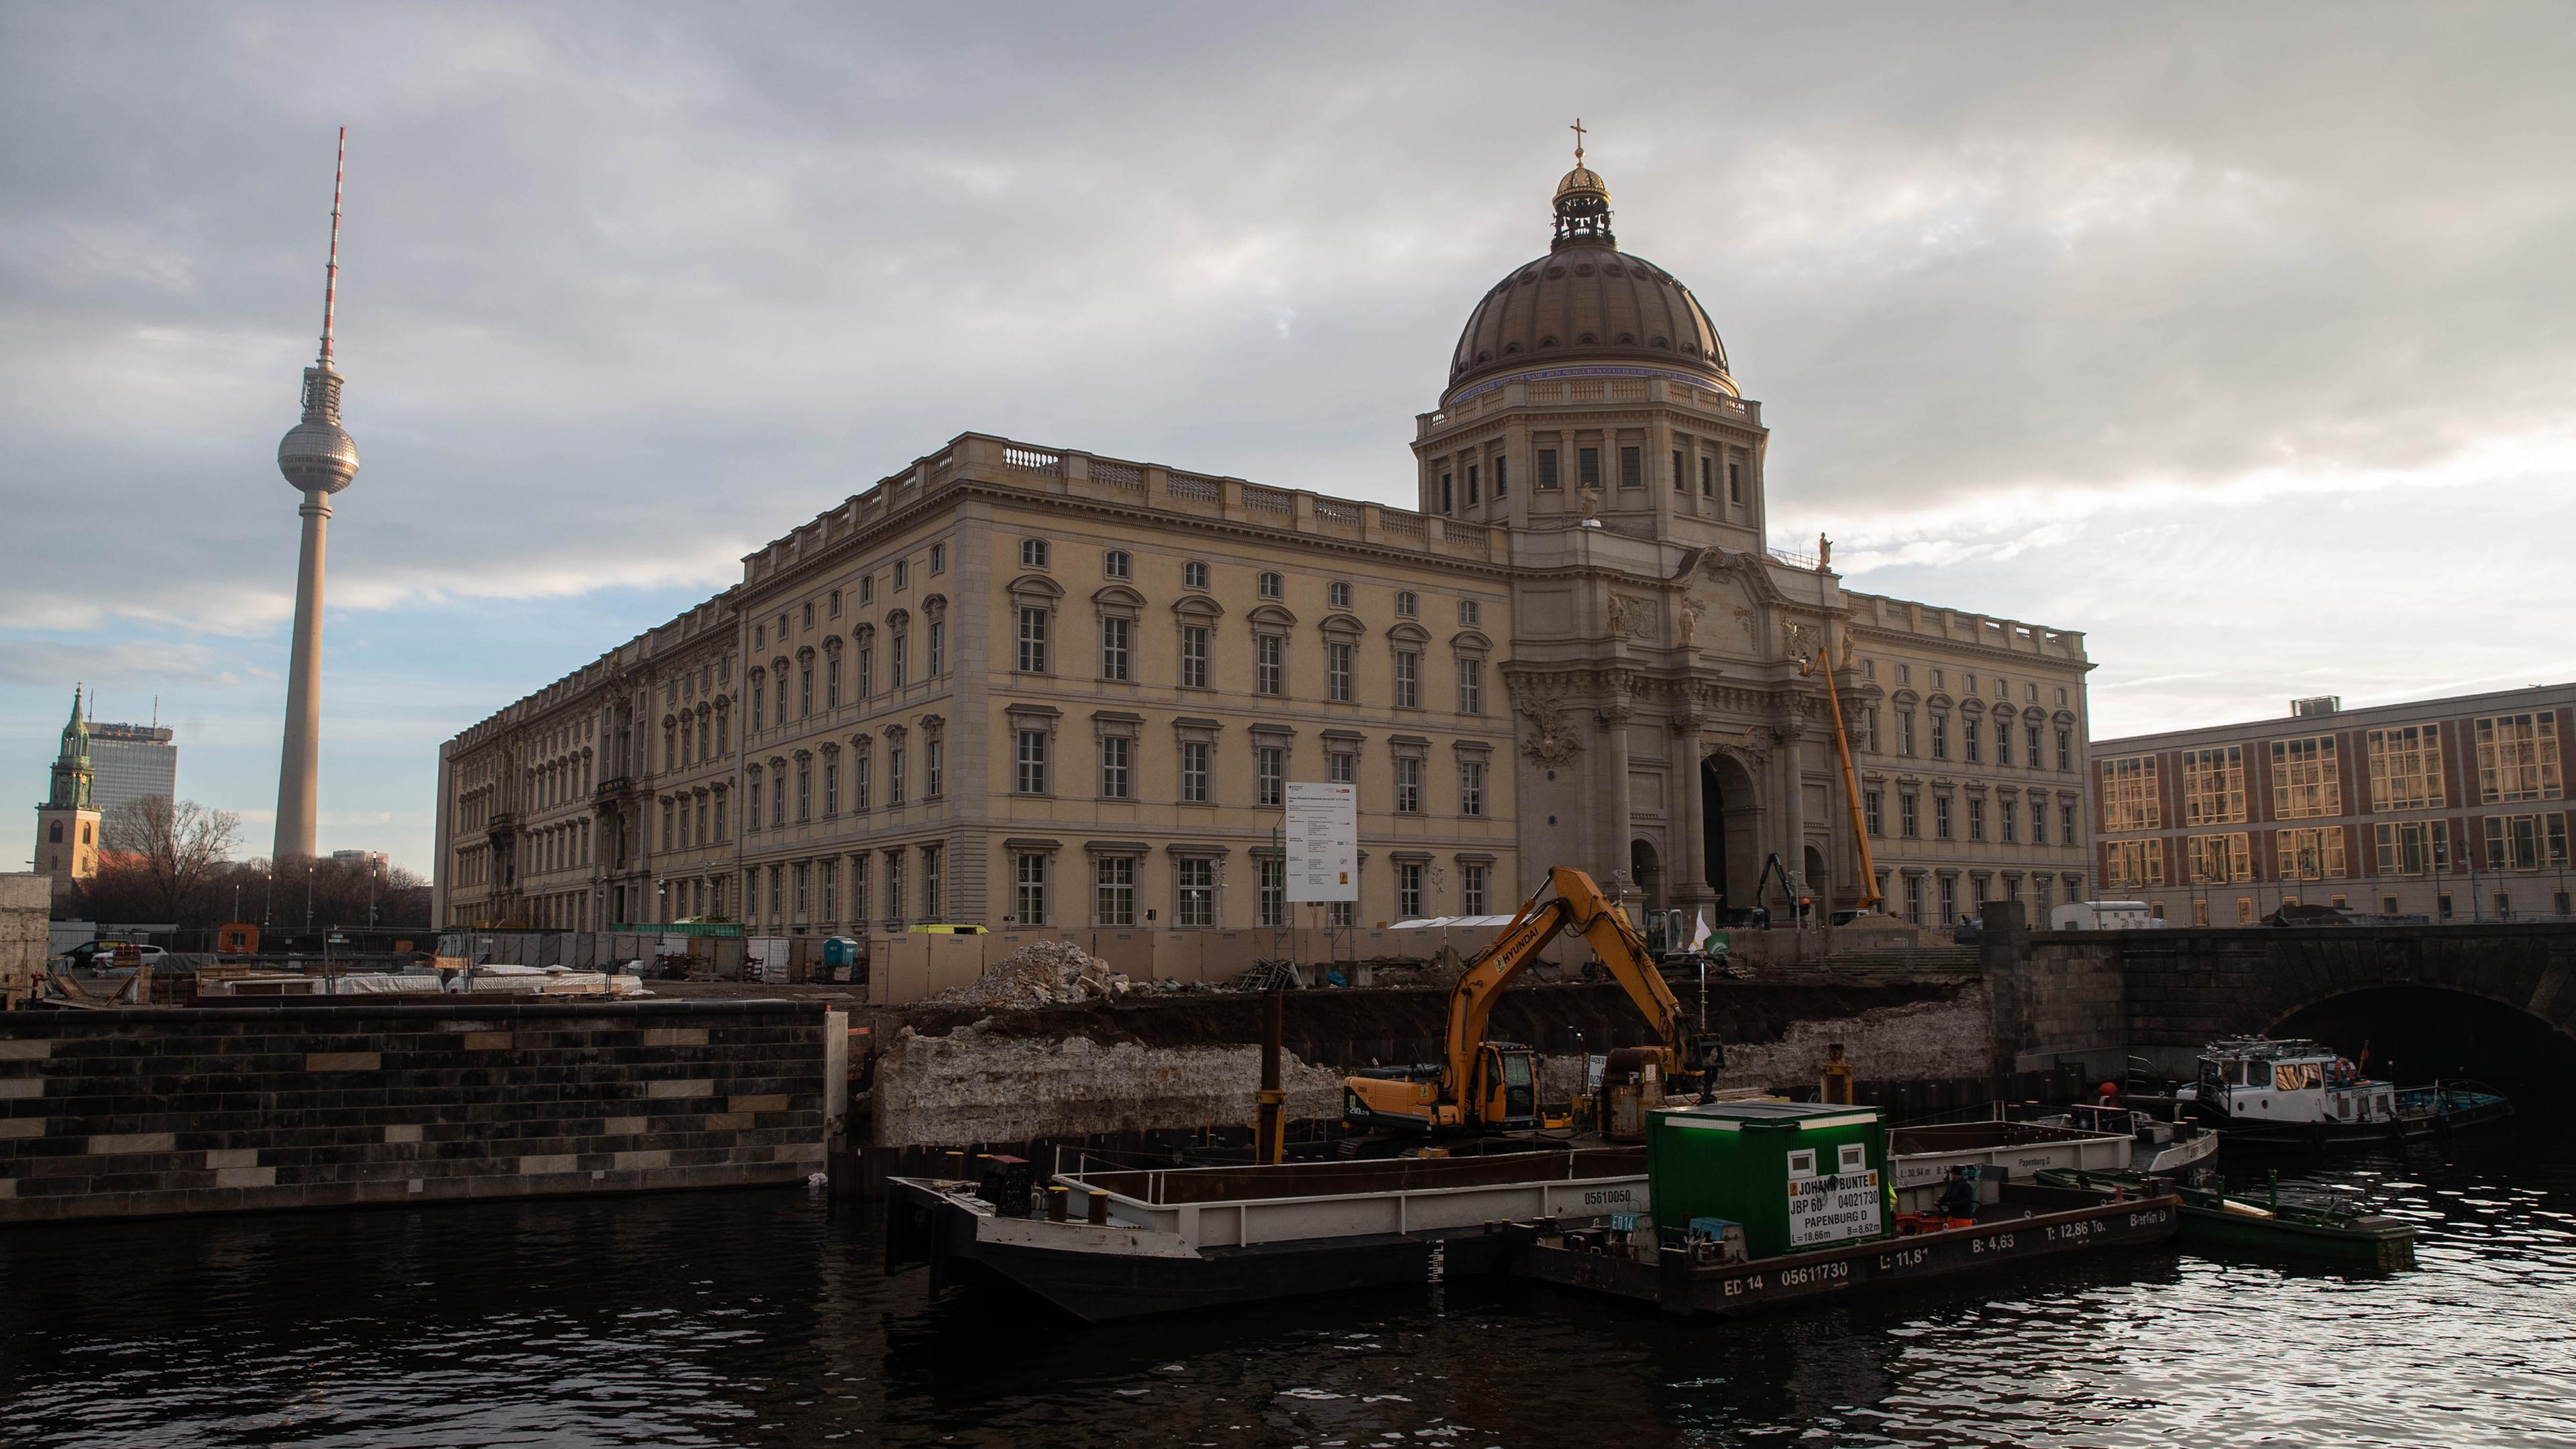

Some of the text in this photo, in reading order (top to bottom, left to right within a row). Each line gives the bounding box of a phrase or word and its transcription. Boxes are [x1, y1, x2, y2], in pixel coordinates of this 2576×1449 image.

[1503, 926, 1539, 964] HYUNDAI
[1799, 1175, 1868, 1195] JOHANN BUNTE
[1585, 1189, 1631, 1205] 05610050
[1790, 1190, 1878, 1215] JBP 60 04021730
[1805, 1210, 1867, 1228] PAPENBURG D
[1792, 1223, 1880, 1243] L=18,66m B=8,62m
[1724, 1279, 1742, 1296] ED
[1747, 1274, 1764, 1290] 14
[1781, 1261, 1848, 1286] 05611730
[1880, 1255, 1890, 1269] L:
[1972, 1238, 1984, 1253] B:
[1989, 1234, 2015, 1252] 4,63
[2045, 1226, 2055, 1240] T:
[2060, 1221, 2088, 1239] 12,86
[2130, 1211, 2157, 1227] Berlin
[2159, 1210, 2166, 1222] D
